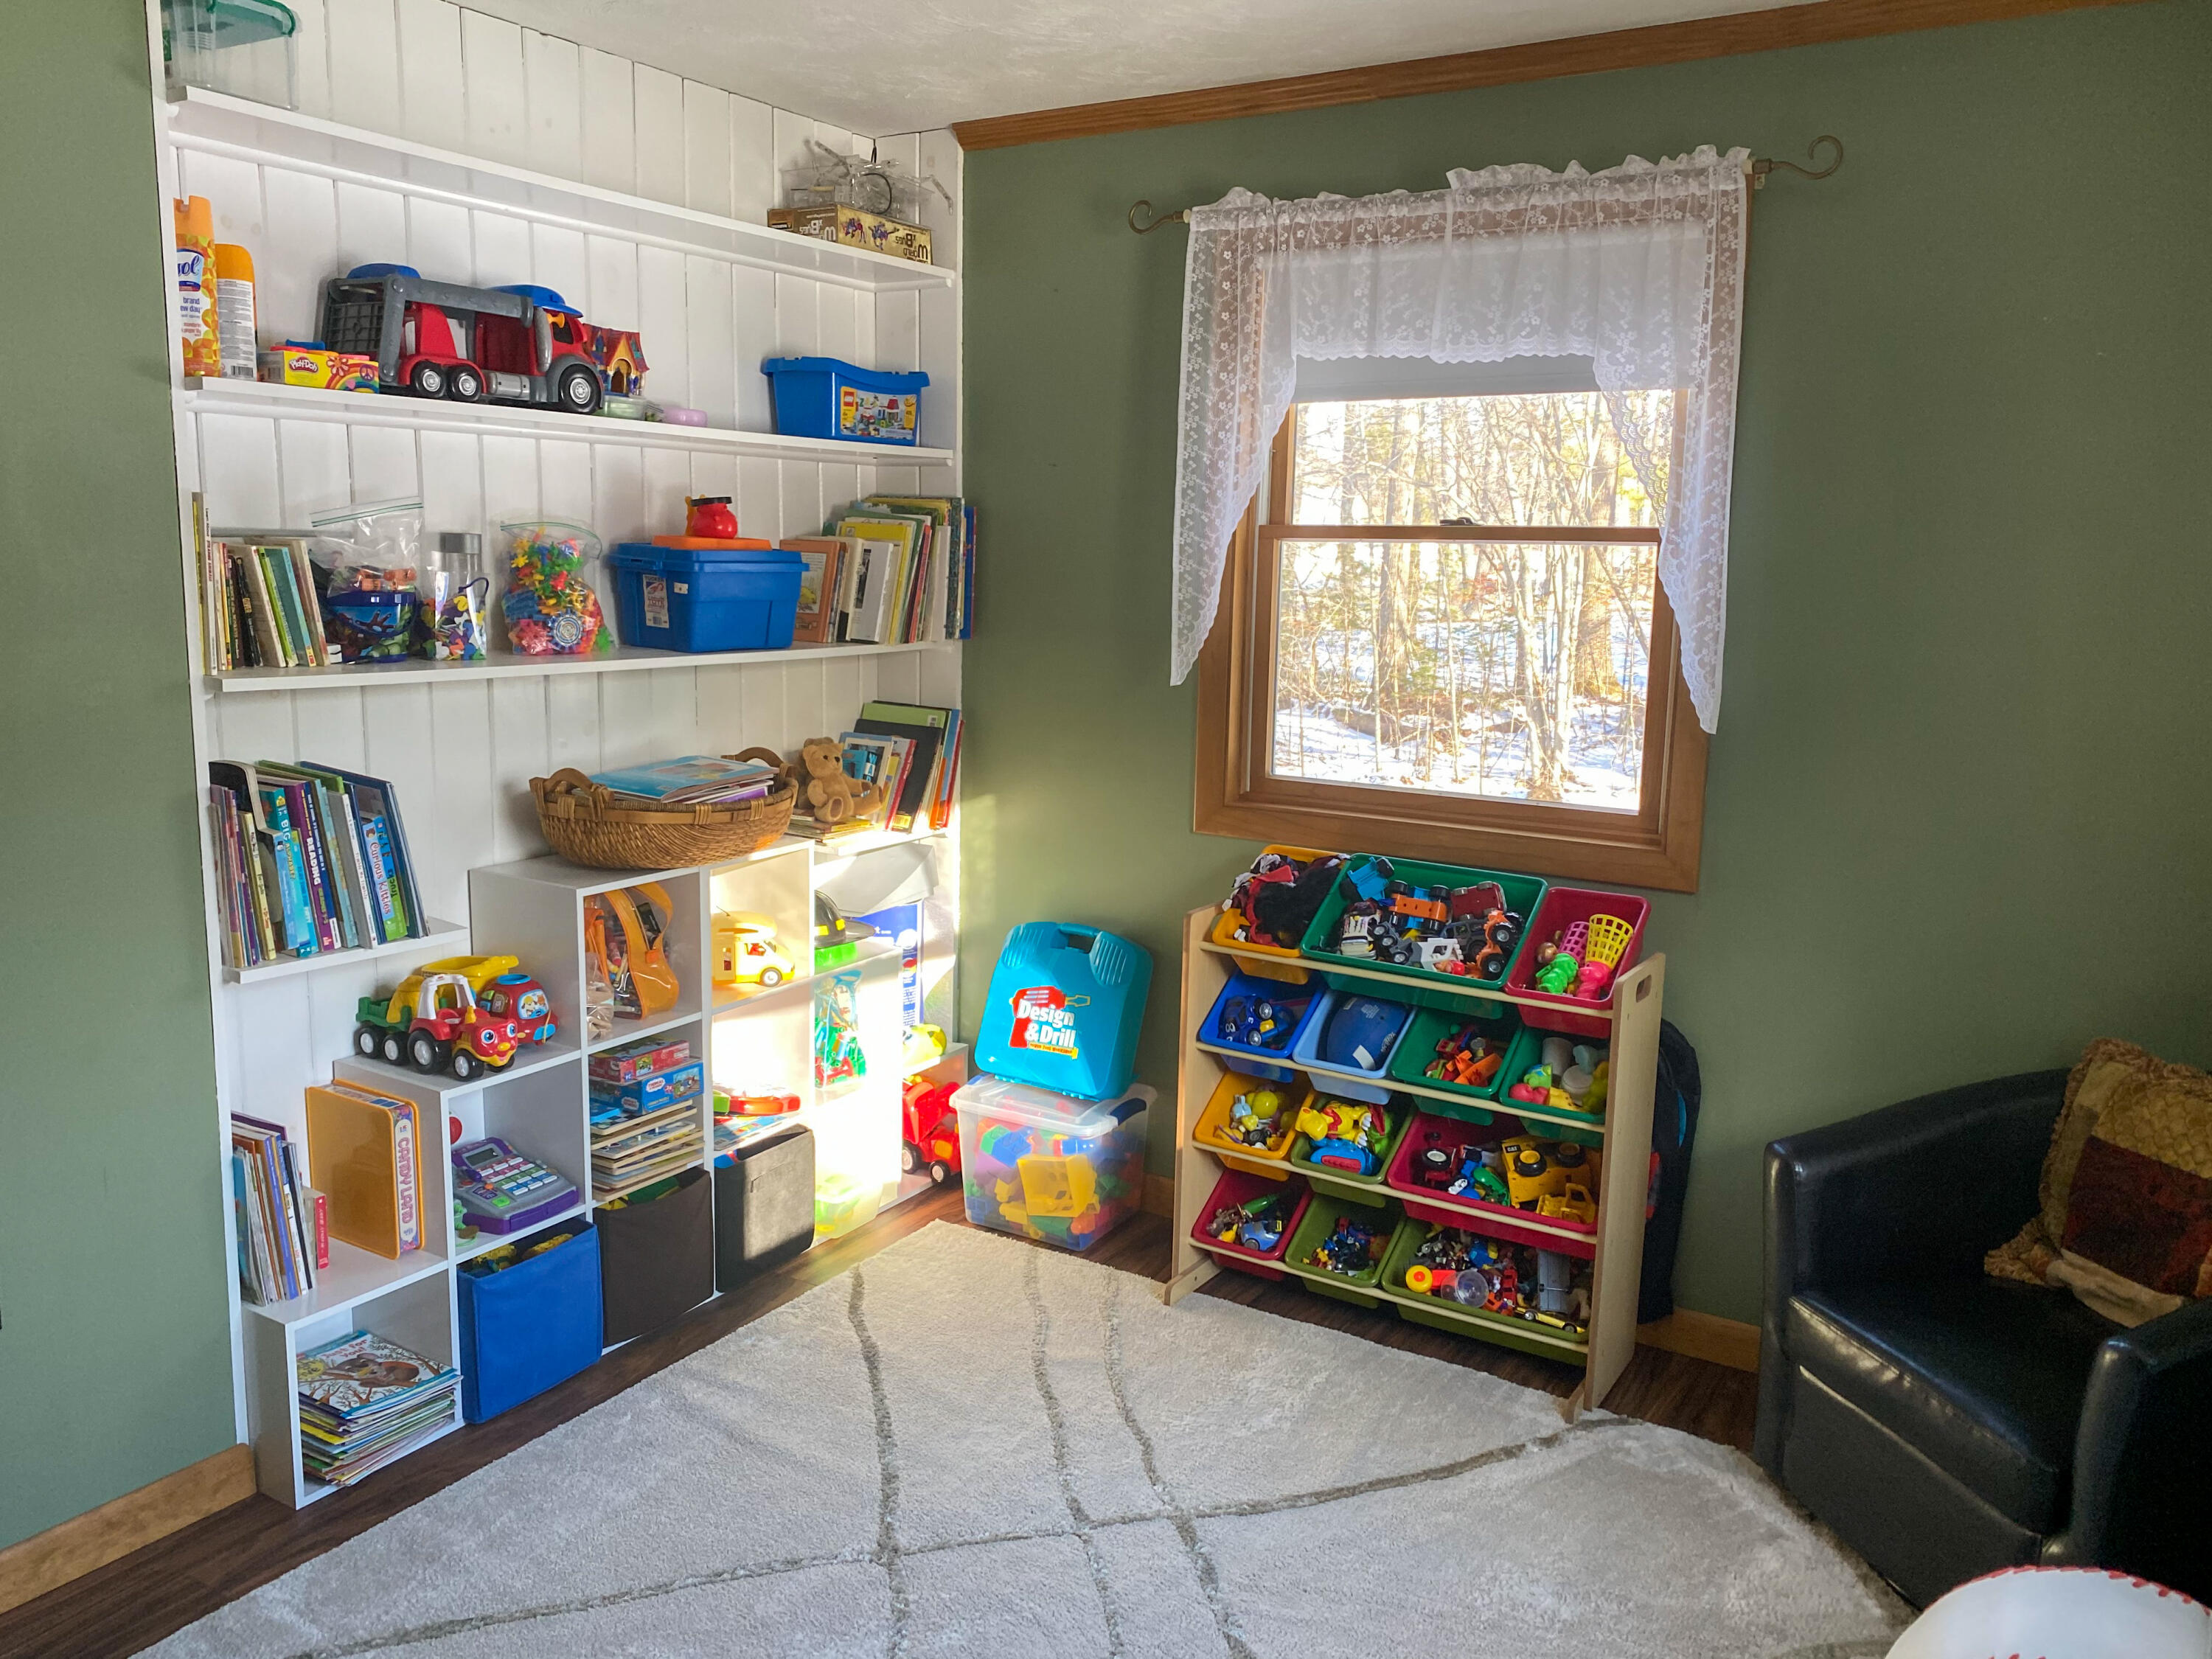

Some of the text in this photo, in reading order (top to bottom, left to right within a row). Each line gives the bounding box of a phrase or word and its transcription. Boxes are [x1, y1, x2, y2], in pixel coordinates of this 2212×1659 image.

[189, 305, 201, 314] day
[280, 819, 291, 841] BIG
[307, 838, 321, 886] READING
[369, 842, 392, 914] Curious Kitties
[1017, 998, 1074, 1029] Design
[397, 1136, 414, 1224] CANDY LAND
[349, 1339, 368, 1349] for
